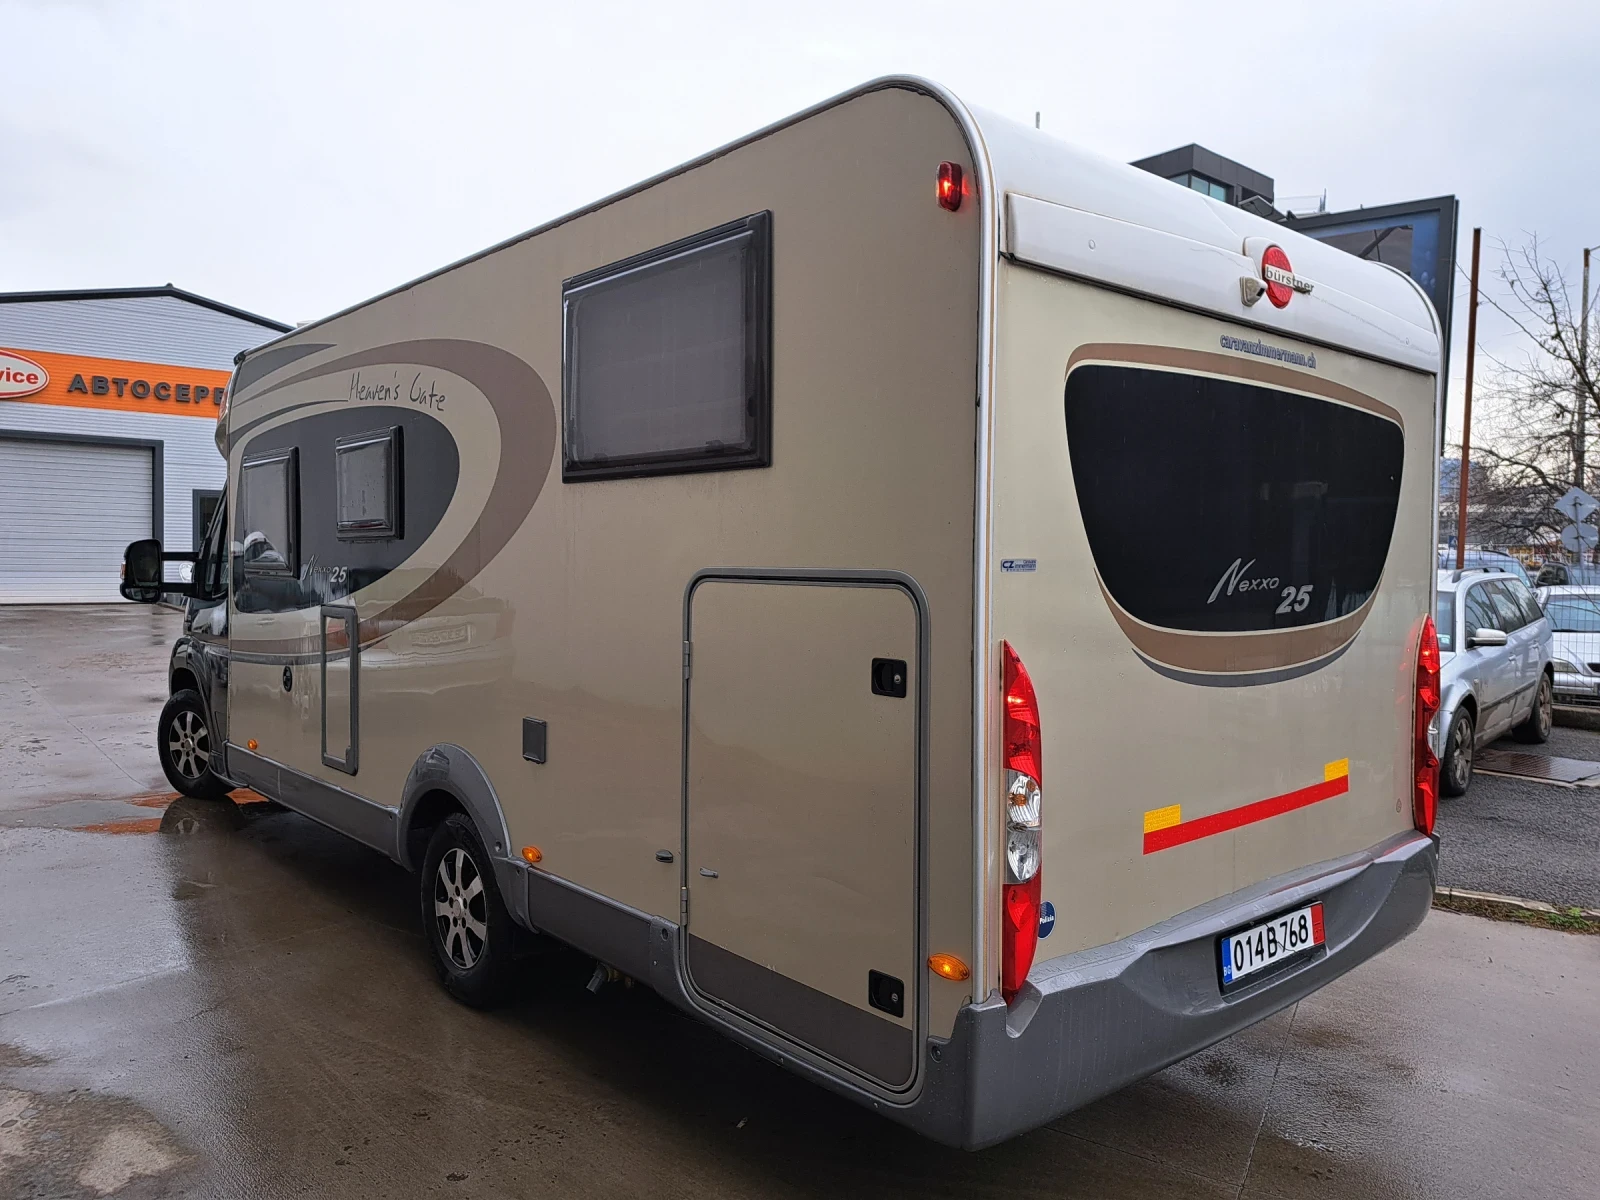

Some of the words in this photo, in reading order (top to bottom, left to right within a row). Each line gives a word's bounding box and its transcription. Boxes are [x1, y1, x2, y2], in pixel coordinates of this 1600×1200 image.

[1265, 266, 1315, 293] bürstner
[1220, 334, 1317, 369] caravanzimmermann.ch
[349, 370, 400, 401] Heaven's
[330, 566, 348, 583] 25
[1207, 557, 1280, 604] Nexxo
[1275, 584, 1314, 614] 25
